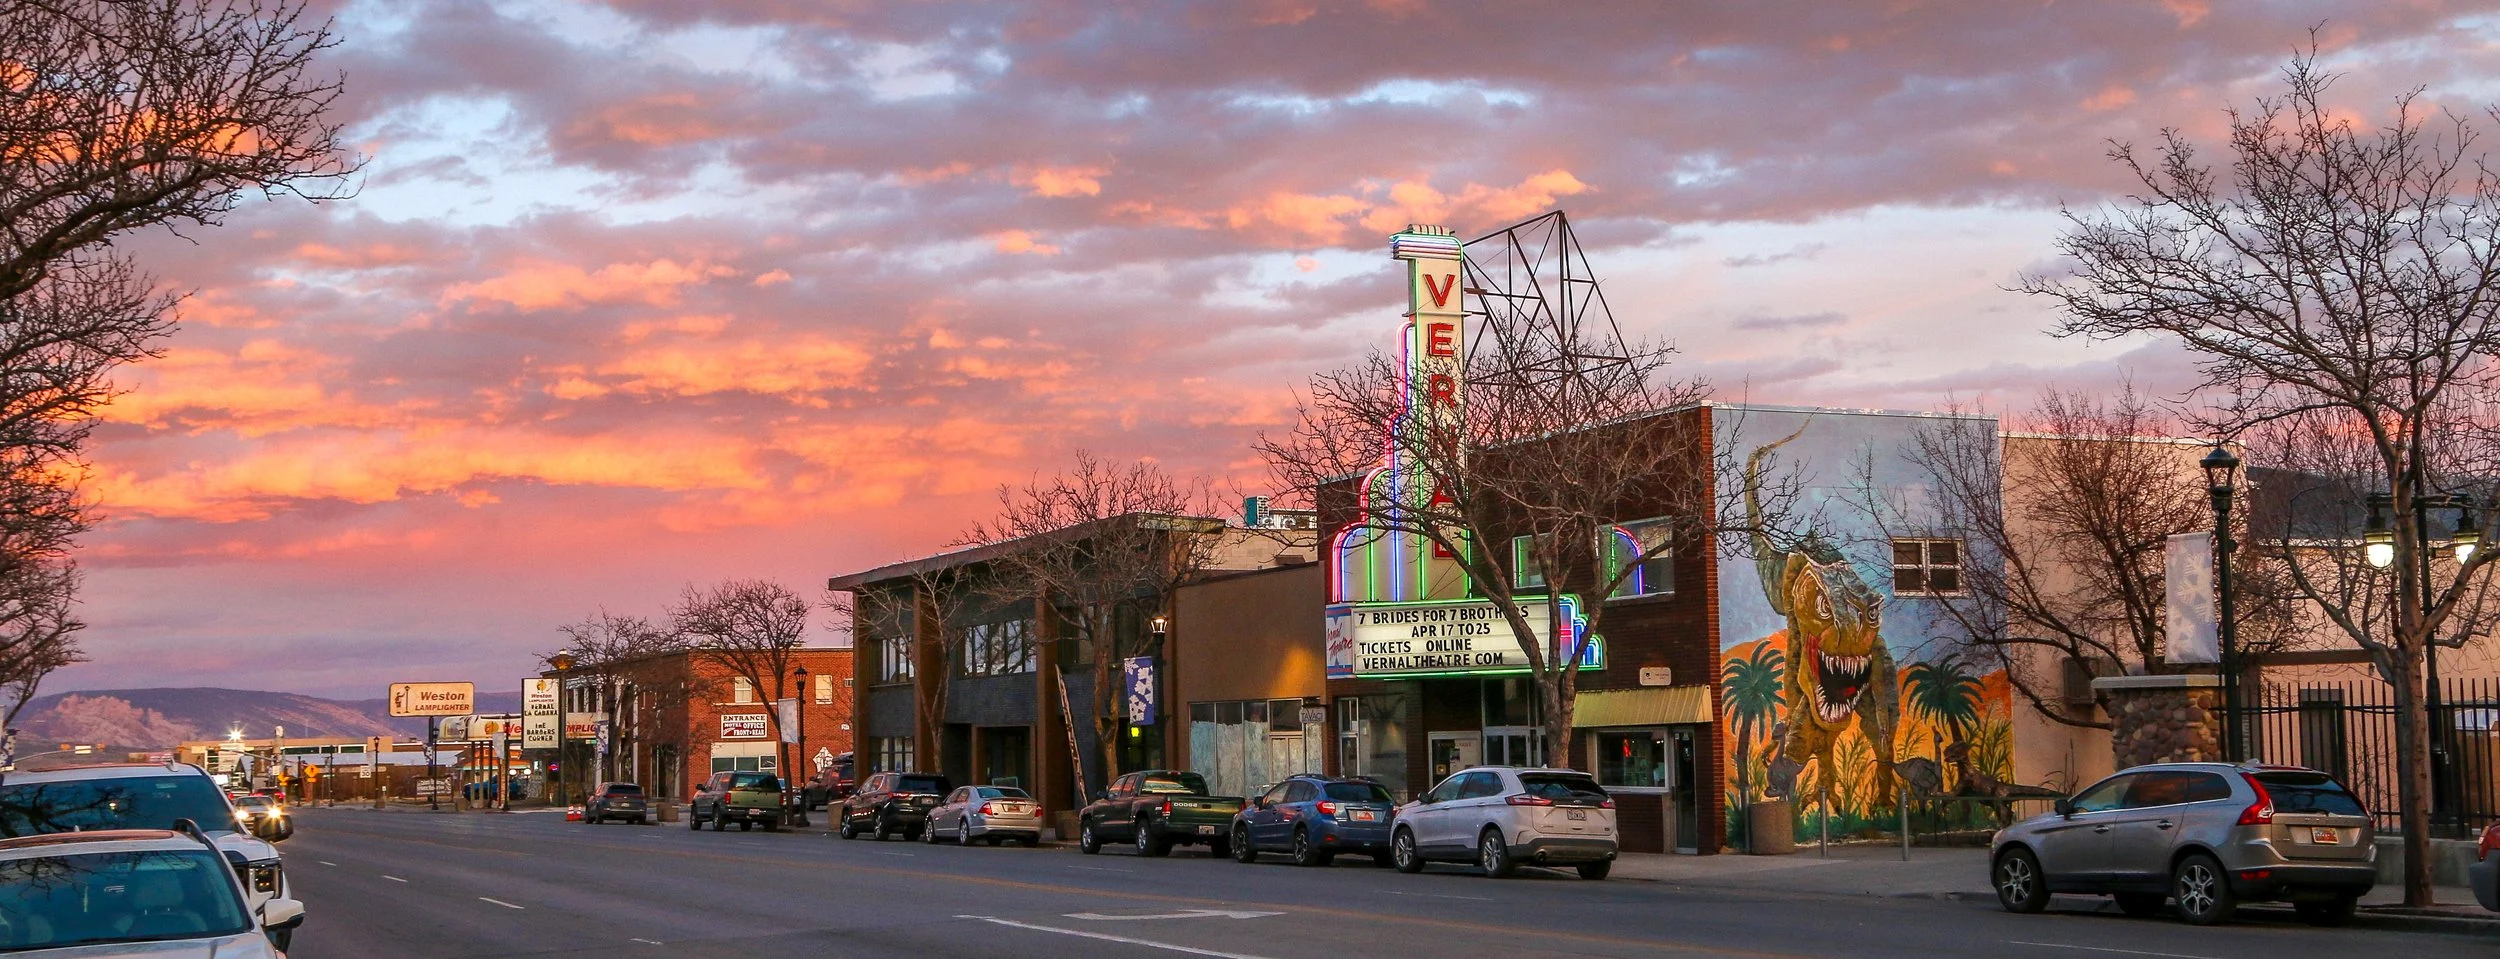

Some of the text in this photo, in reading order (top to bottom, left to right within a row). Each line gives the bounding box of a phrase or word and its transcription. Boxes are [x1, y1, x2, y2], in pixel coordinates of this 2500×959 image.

[1358, 605, 1529, 625] 7 BRIDES FOR 7 BROTHS
[1411, 622, 1490, 637] APR 17 TO 25
[1359, 639, 1472, 655] TICKETS ONLINE
[1363, 652, 1503, 669] VERNALTHEATRE COM
[421, 691, 465, 701] Weston
